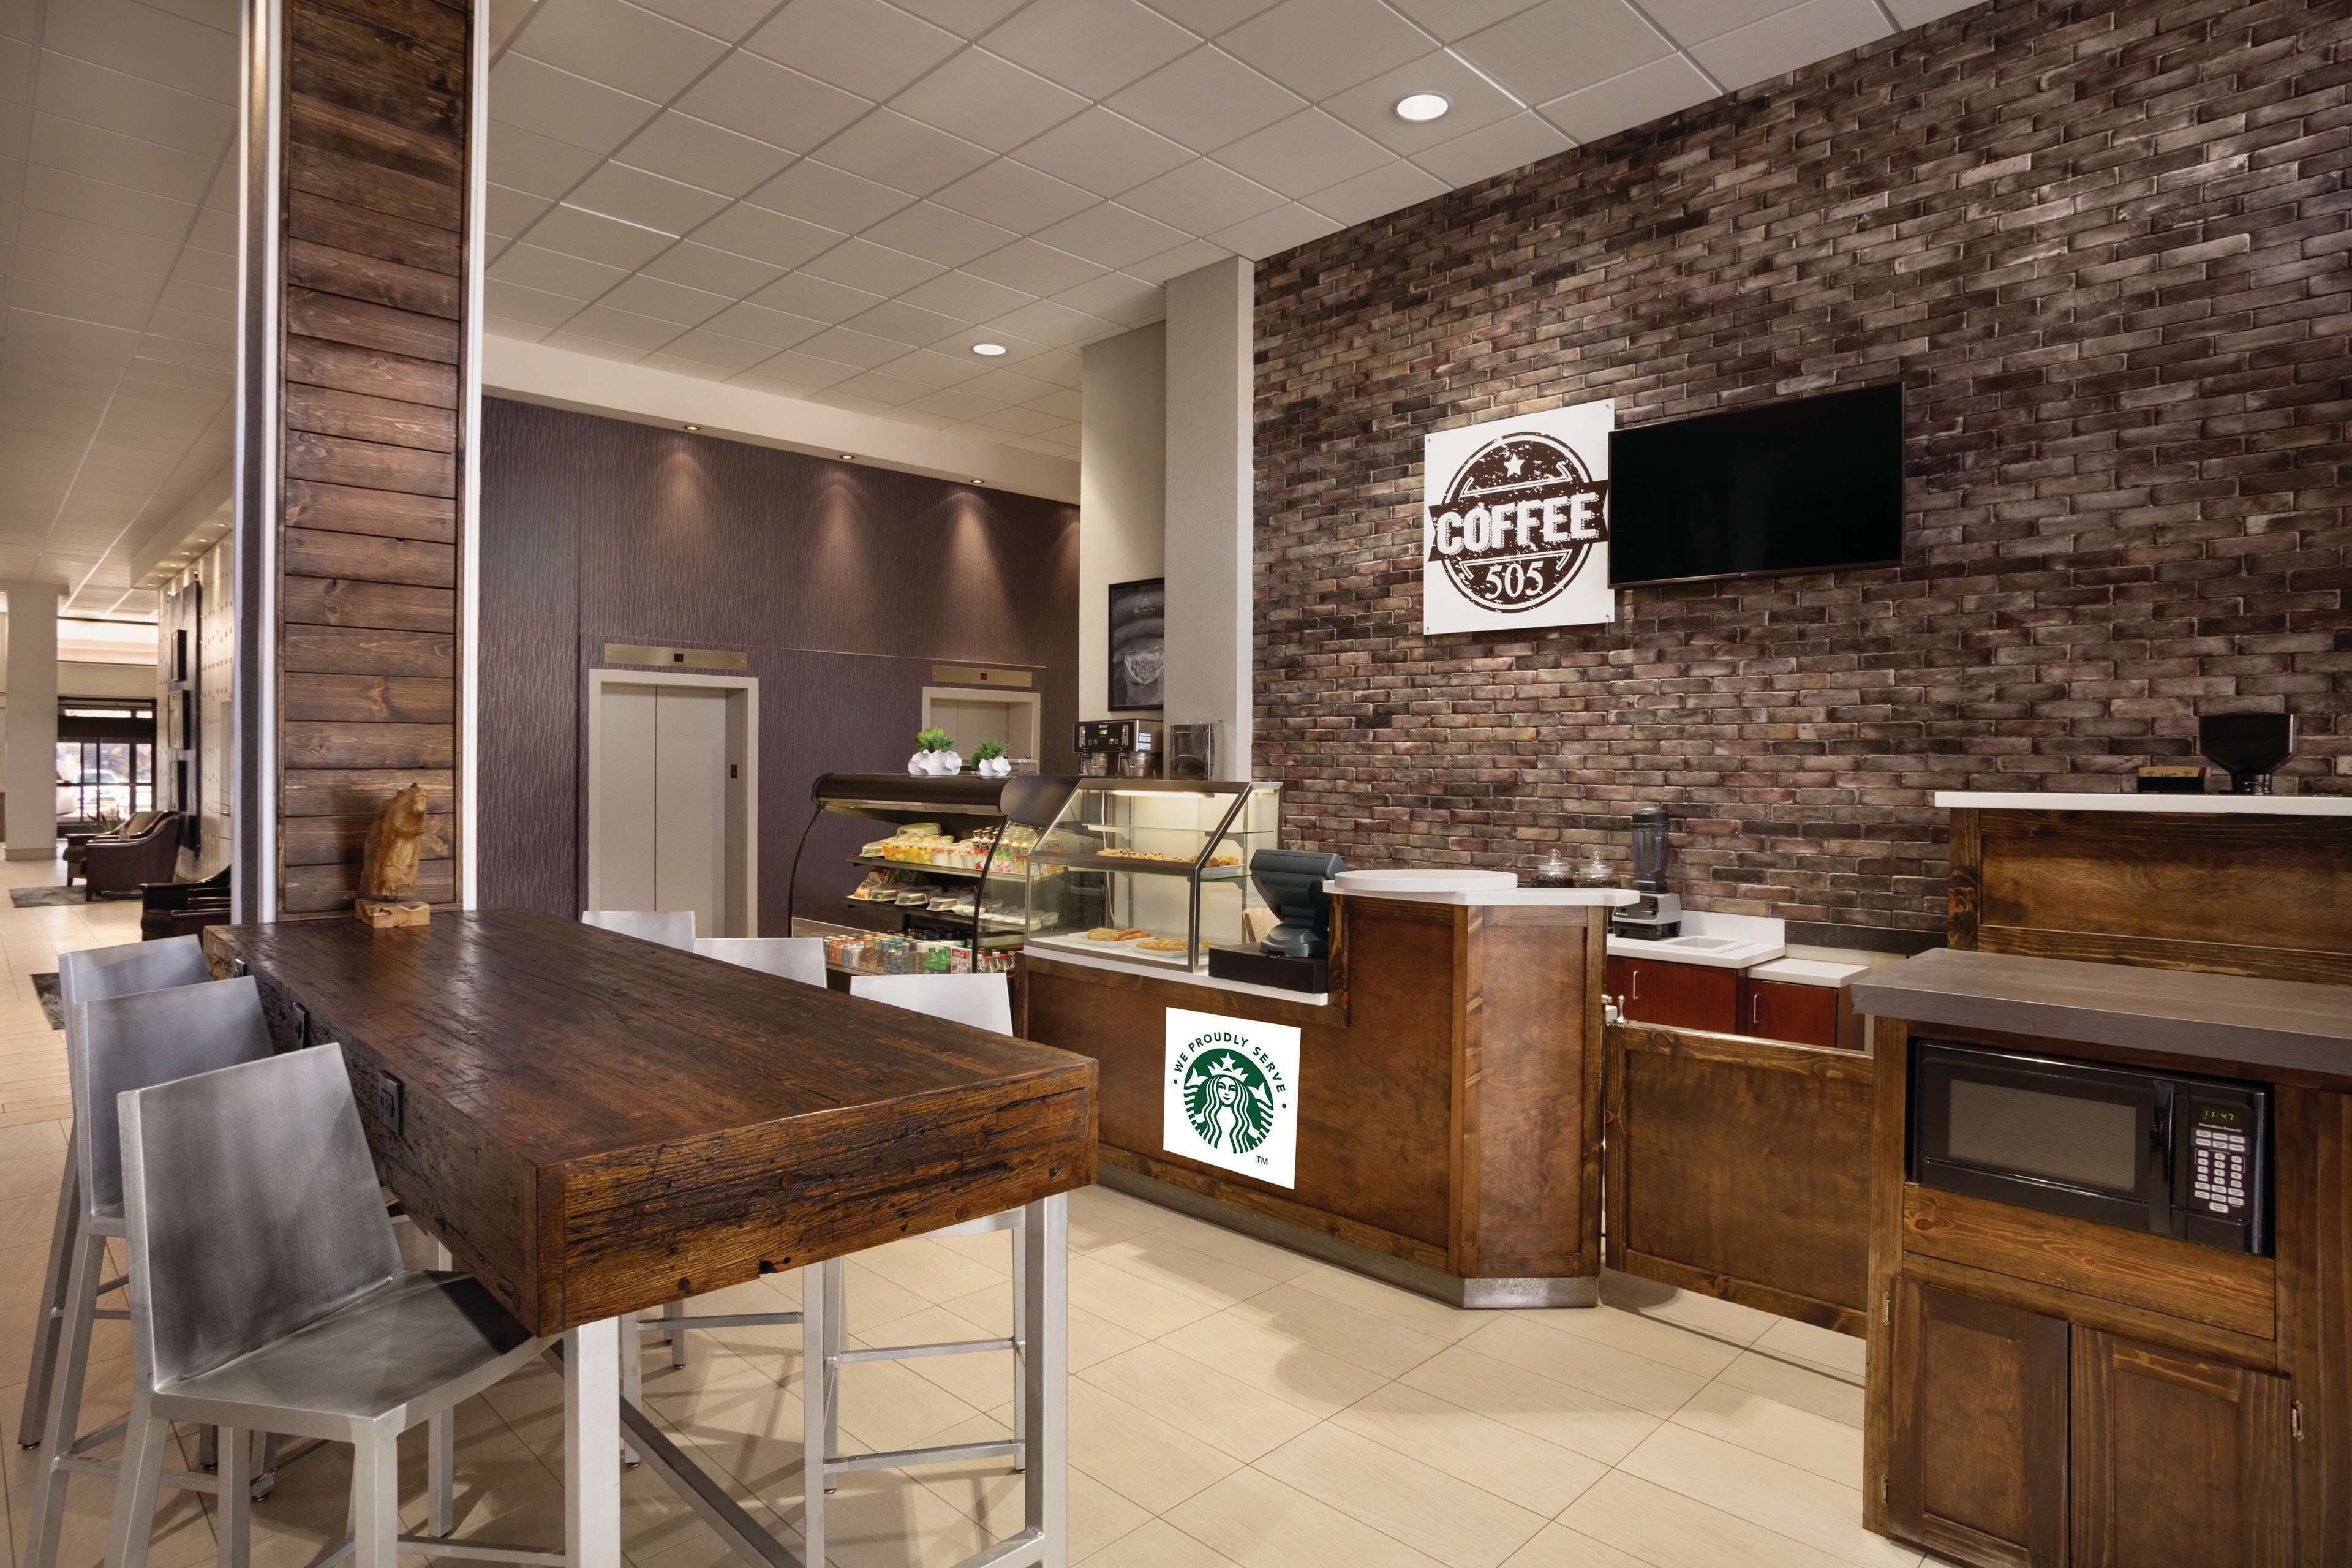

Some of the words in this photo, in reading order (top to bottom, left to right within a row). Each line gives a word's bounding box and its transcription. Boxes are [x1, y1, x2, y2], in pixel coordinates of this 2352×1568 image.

[1436, 492, 1599, 555] COFFEE
[1485, 560, 1544, 600] 505
[1174, 1052, 1188, 1072] WE
[1188, 1032, 1248, 1052] PROUDLY
[1253, 1046, 1286, 1093] SERVE
[2205, 1110, 2234, 1120] 11:47
[1256, 1155, 1268, 1165] TM
